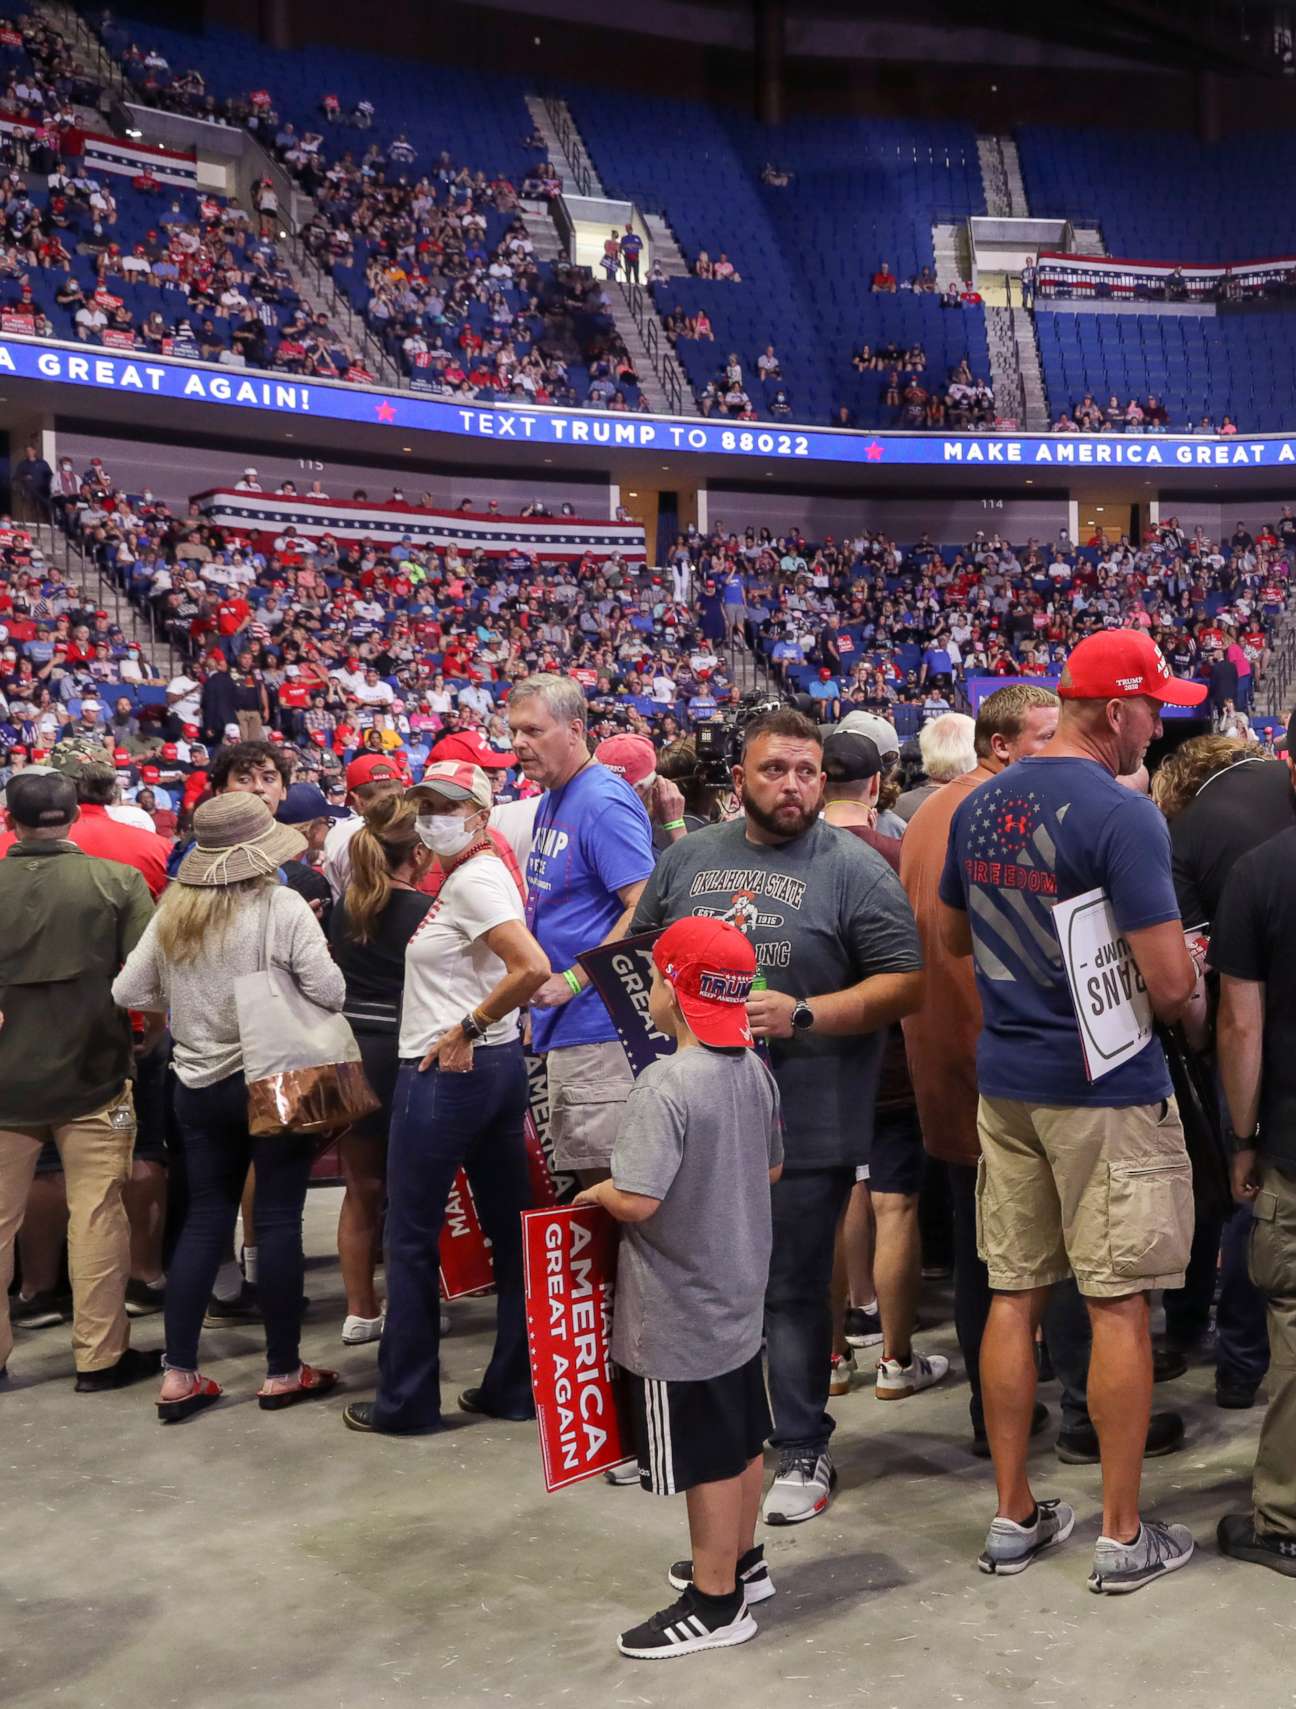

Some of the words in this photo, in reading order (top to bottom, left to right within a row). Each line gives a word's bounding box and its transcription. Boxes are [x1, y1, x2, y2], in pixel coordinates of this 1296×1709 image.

[37, 352, 166, 391] GREAT
[183, 377, 310, 411] AGAIN!
[458, 410, 537, 437] TEXT
[550, 419, 656, 445] TRUMP
[669, 427, 707, 449] TO
[721, 431, 809, 455] 88022
[943, 441, 1022, 462] MAKE
[1035, 442, 1163, 464] AMERICA
[1176, 444, 1265, 464] GREAT
[299, 459, 325, 471] 115
[982, 499, 1004, 509] 114
[1115, 676, 1144, 687] TRUMP
[689, 869, 767, 898] OKLAHOMA
[765, 872, 807, 911] STATE
[963, 858, 1059, 895] FREEDOM
[544, 1222, 569, 1341] GREAT
[568, 1220, 609, 1463] AMERICA
[551, 1353, 581, 1470] AGAIN
